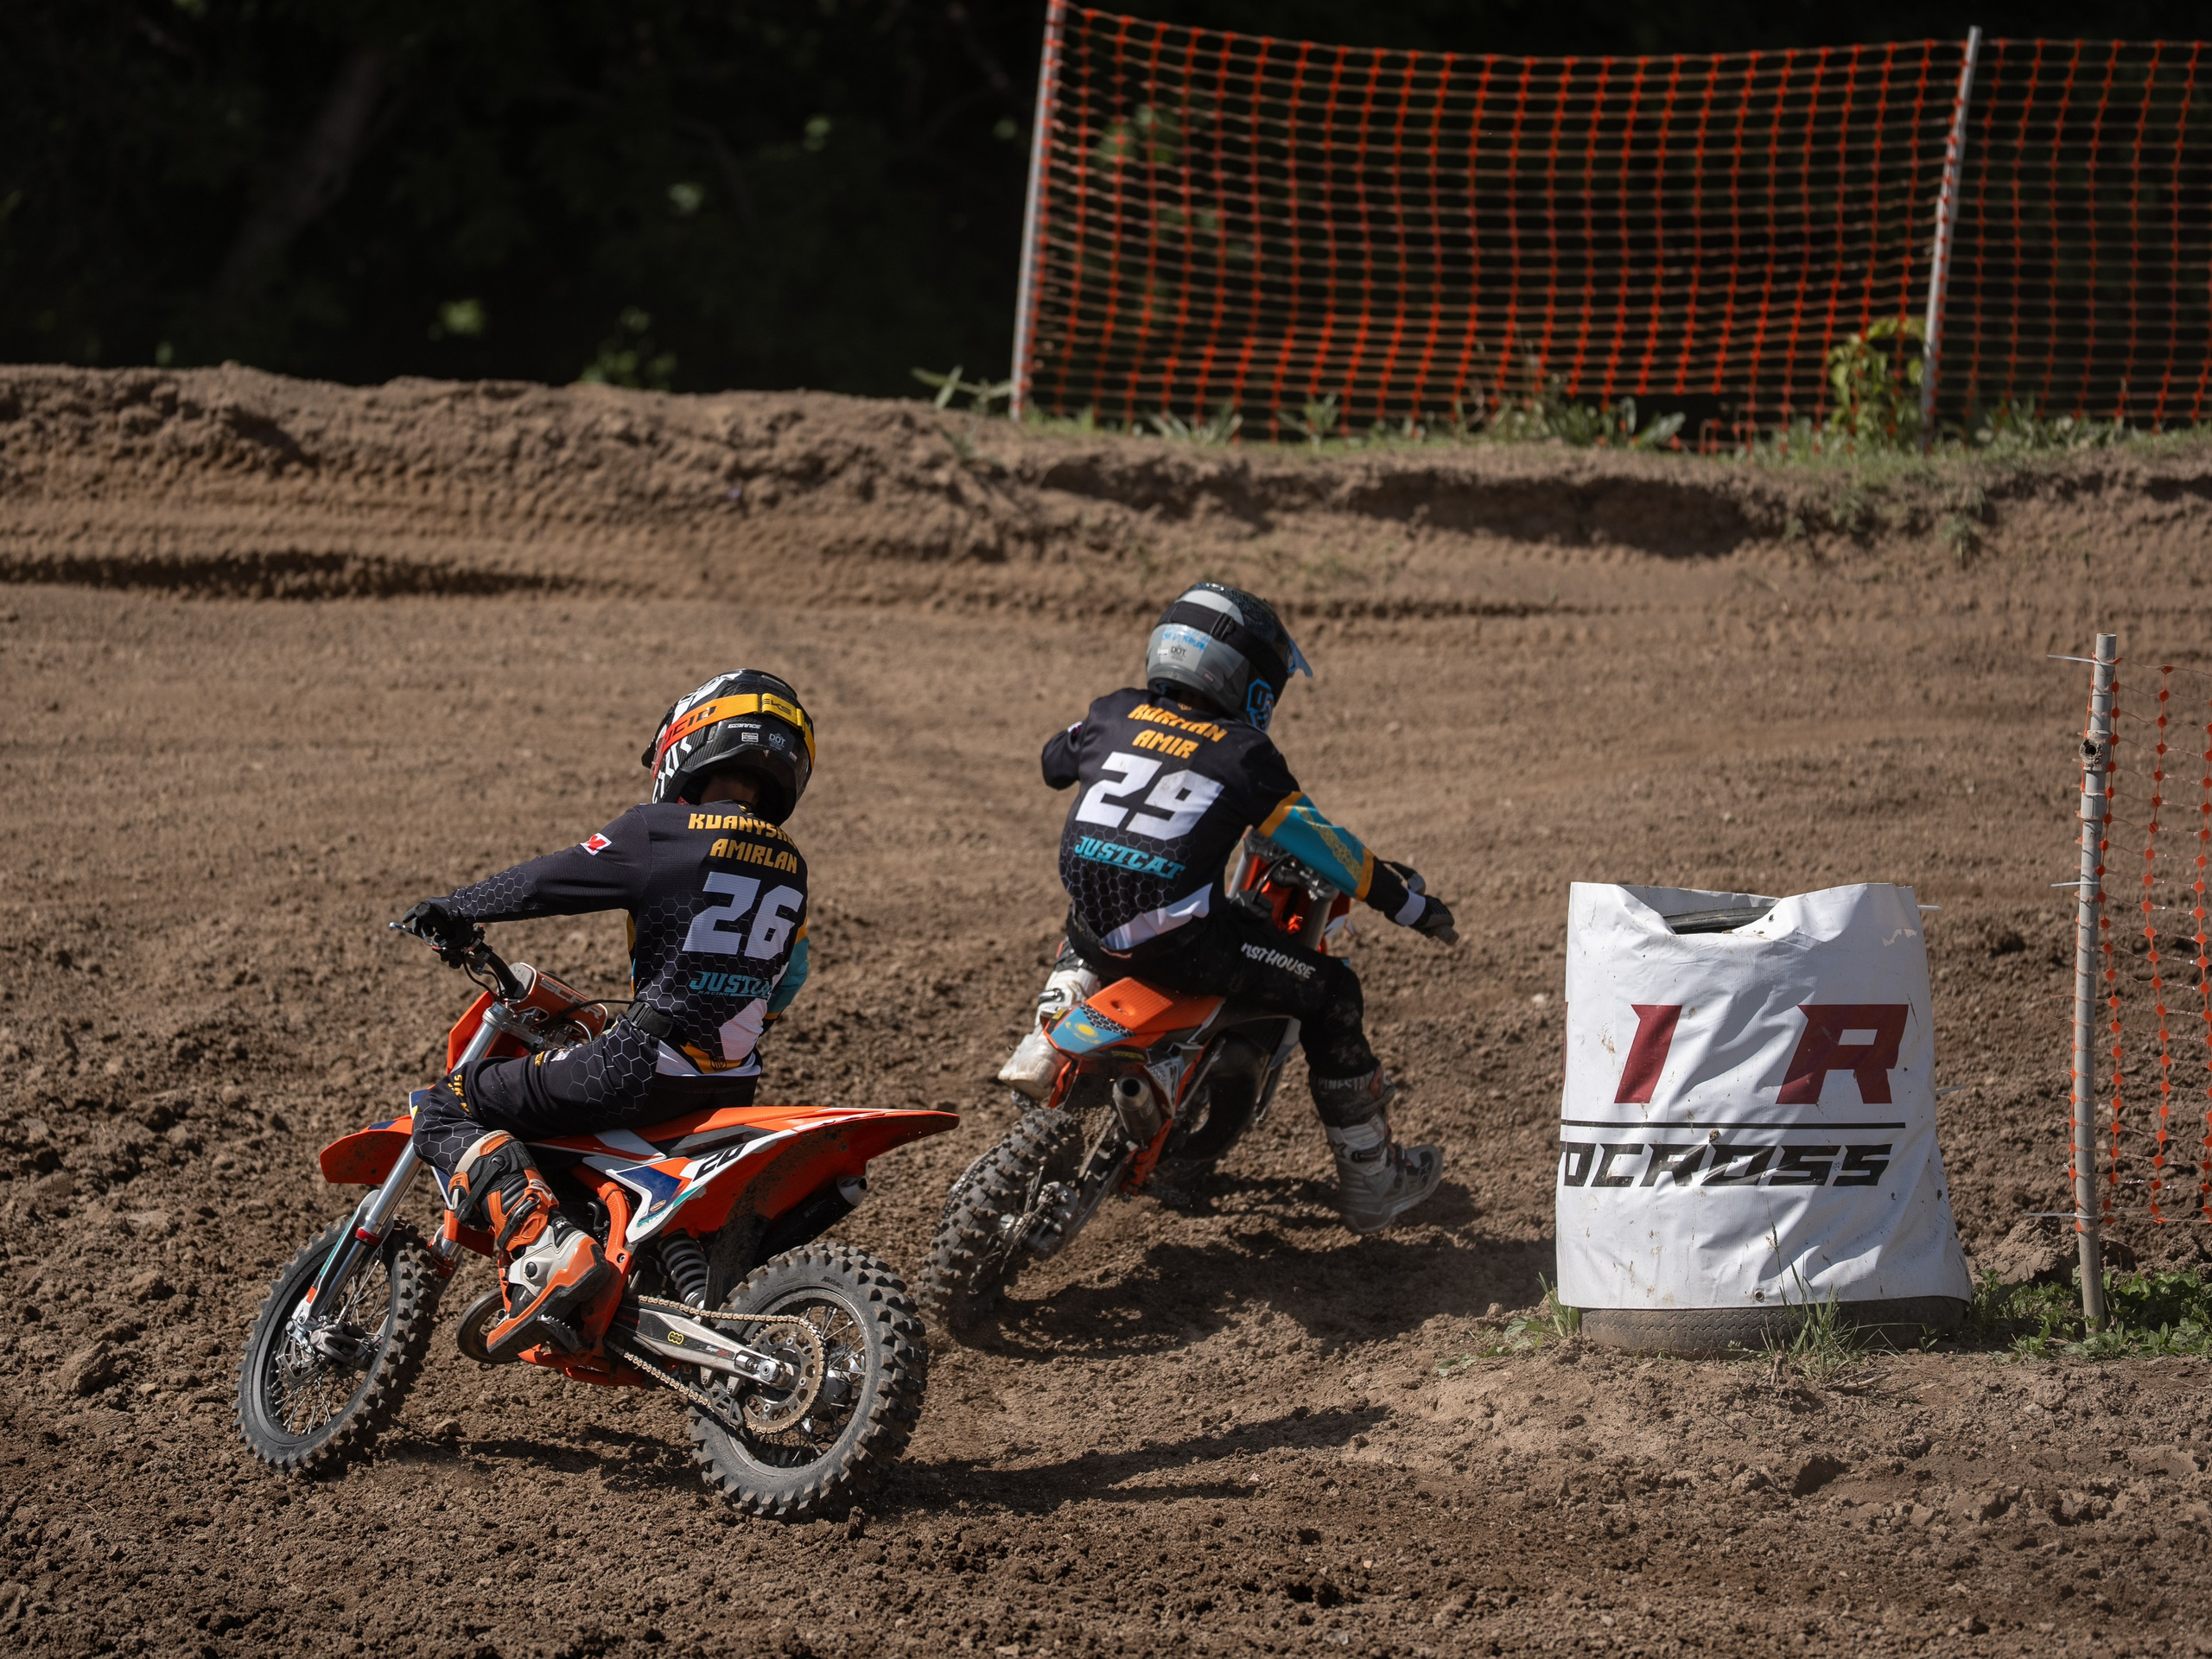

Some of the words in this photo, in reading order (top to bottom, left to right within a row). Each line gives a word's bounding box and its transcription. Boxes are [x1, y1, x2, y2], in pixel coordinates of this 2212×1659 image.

[768, 733, 786, 746] DOT
[1131, 729, 1199, 760] AMIR
[1075, 751, 1225, 842] 29
[709, 838, 798, 874] AMIRLAN
[1074, 836, 1185, 880] JUSTCAT
[682, 871, 804, 960] 26
[1776, 1004, 1909, 1104] R
